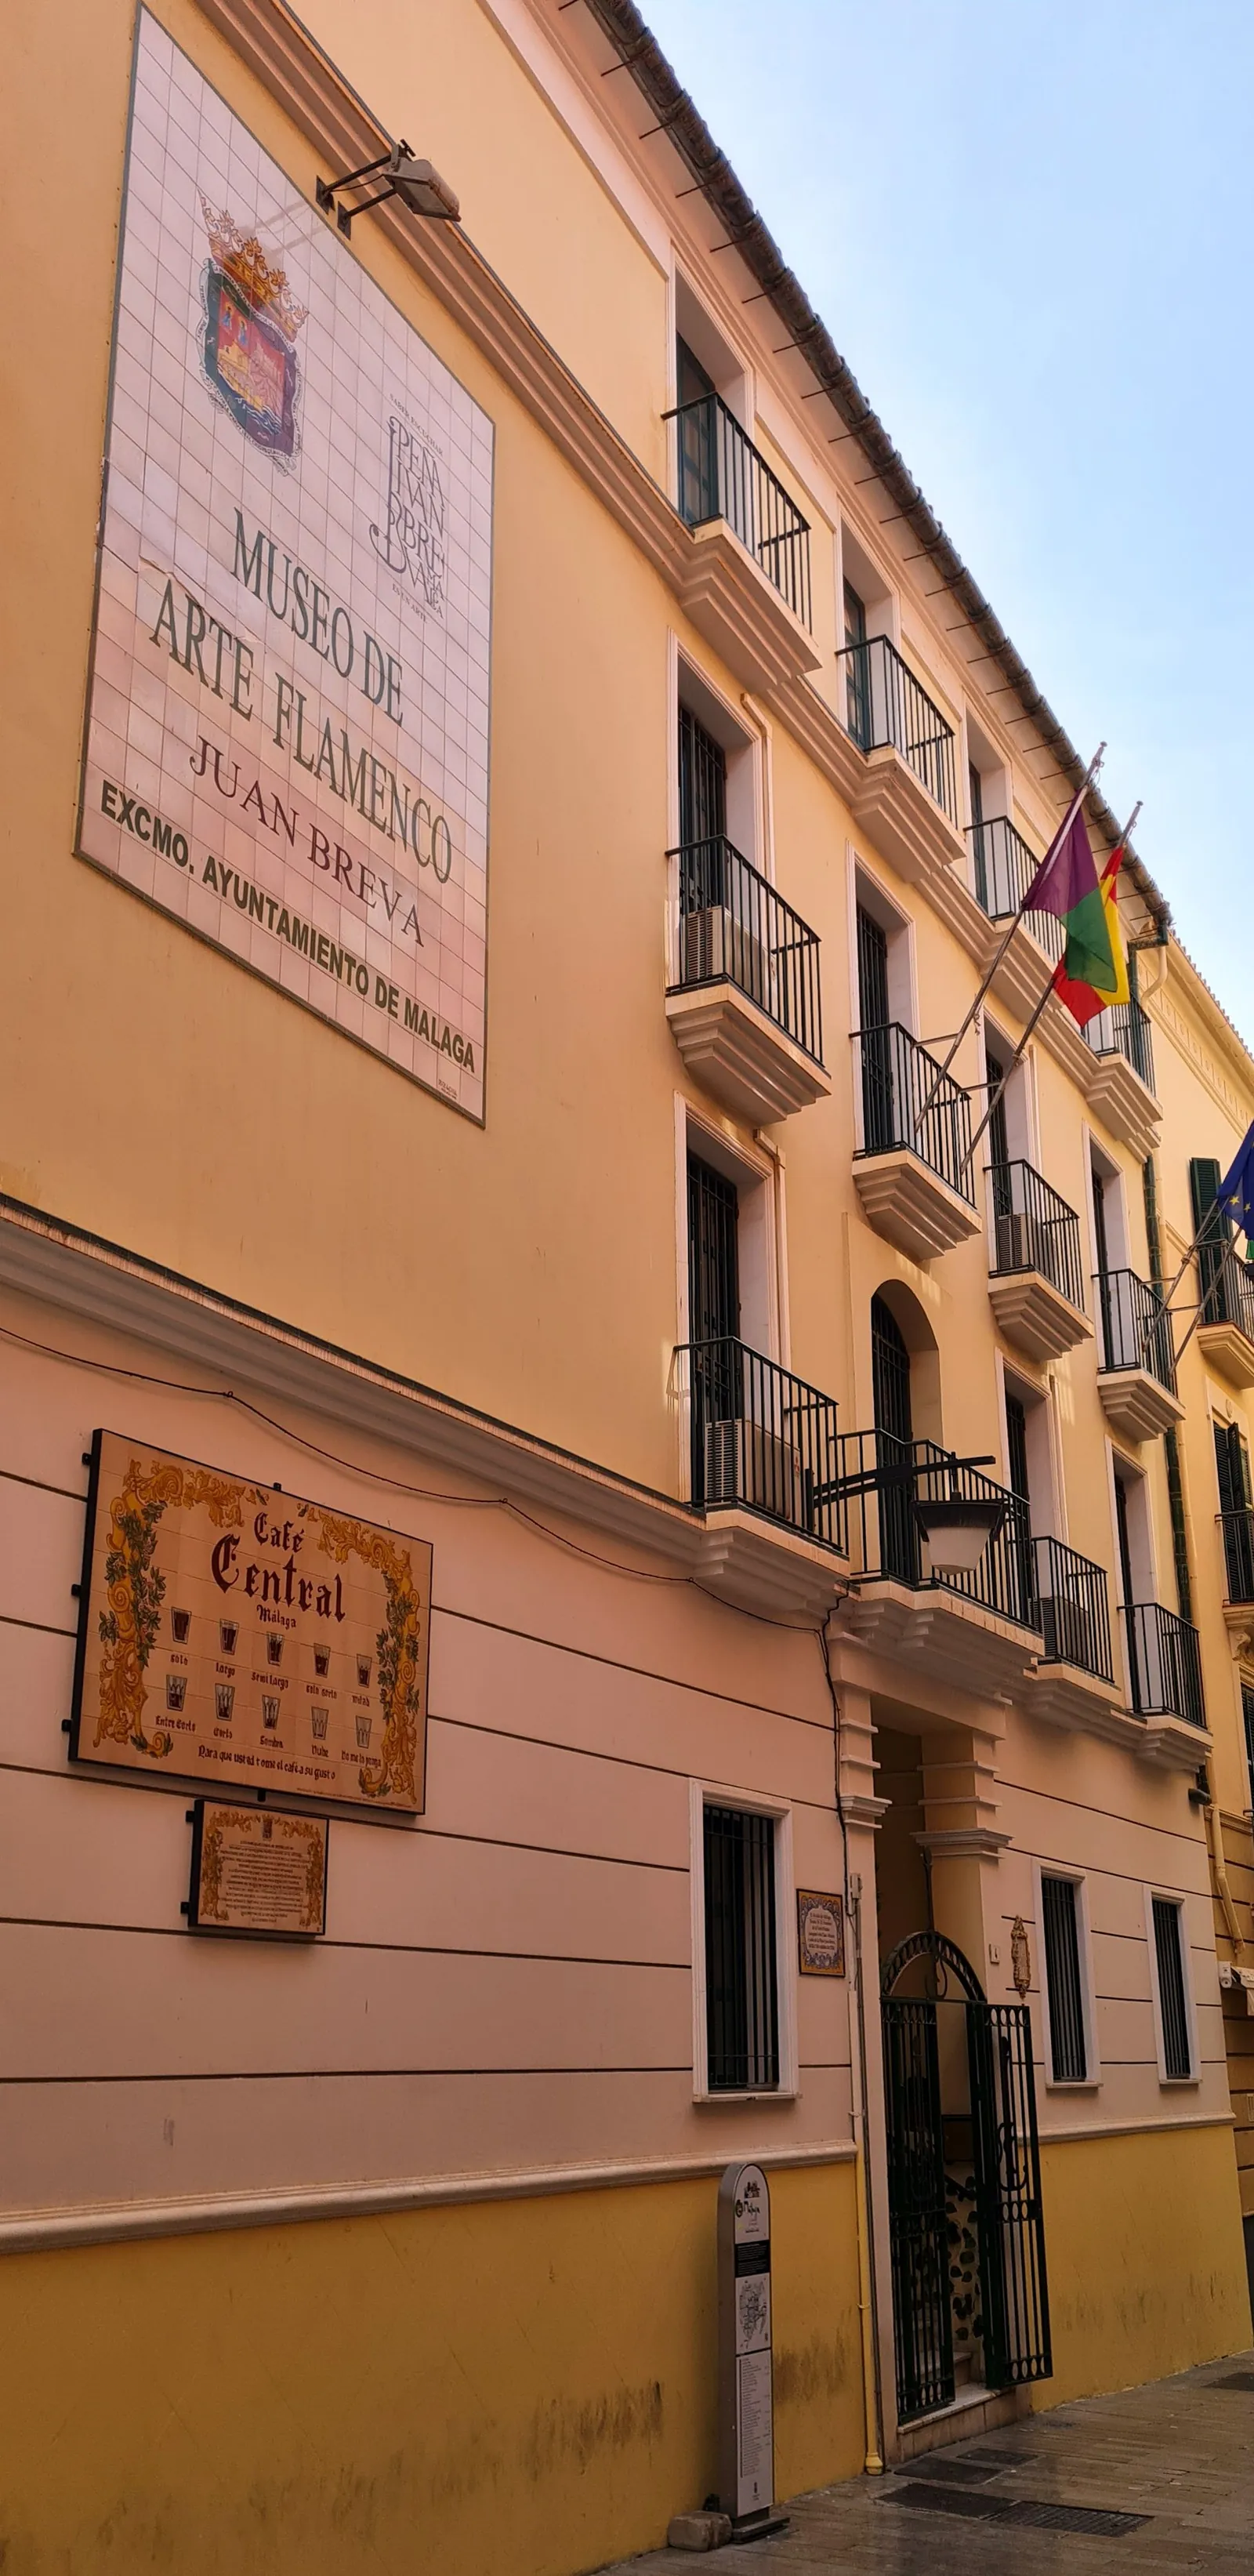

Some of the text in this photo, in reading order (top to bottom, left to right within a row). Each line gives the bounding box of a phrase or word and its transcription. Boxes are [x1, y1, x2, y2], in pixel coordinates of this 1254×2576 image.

[231, 506, 353, 679] MUSEO
[361, 629, 404, 727] DE
[149, 579, 452, 884] ARTE FLAMENCO
[189, 735, 425, 948] JUAN BREVA
[100, 780, 476, 1073] EXCMO. AYUNTAMIENTO DE MALAGA
[211, 1533, 346, 1624] Central
[254, 1511, 304, 1554] Café
[256, 1604, 296, 1630] Málaga
[198, 1744, 336, 1781] Para que usted tome el café a su gusto
